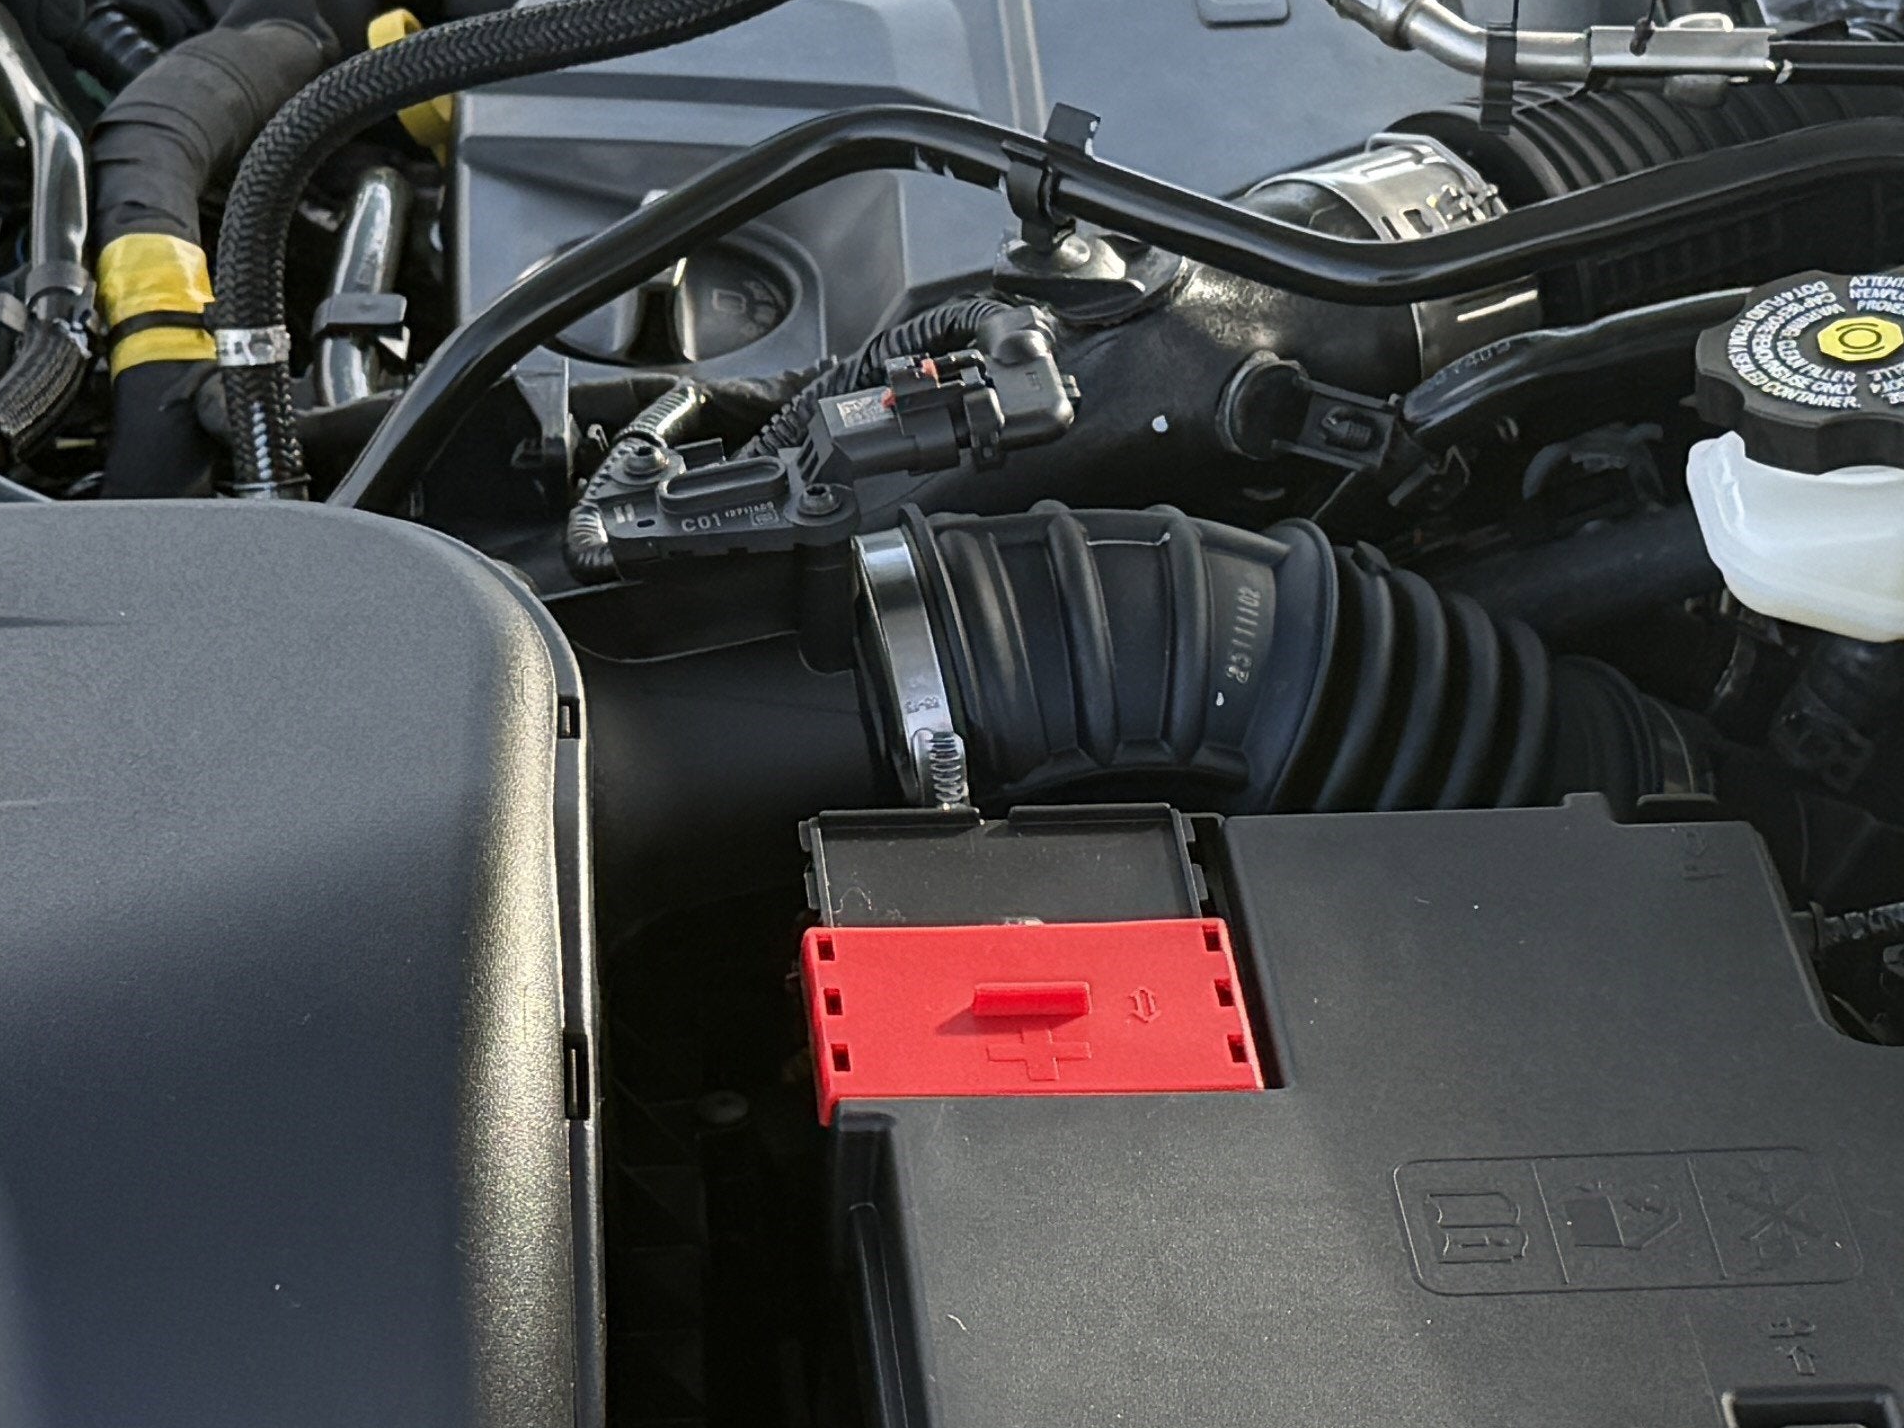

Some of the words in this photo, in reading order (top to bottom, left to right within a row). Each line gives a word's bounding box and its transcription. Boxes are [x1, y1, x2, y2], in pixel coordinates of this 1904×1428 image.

[1792, 281, 1829, 297] DOT
[1745, 296, 1787, 320] FLUID
[1803, 292, 1837, 308] CAP
[1728, 319, 1757, 346] FROM
[1728, 353, 1769, 385] SEALED
[1799, 363, 1856, 382] FILLER
[1762, 381, 1862, 408] CONTAINER.
[1811, 381, 1858, 395] ONLY
[1869, 382, 1885, 393] 4
